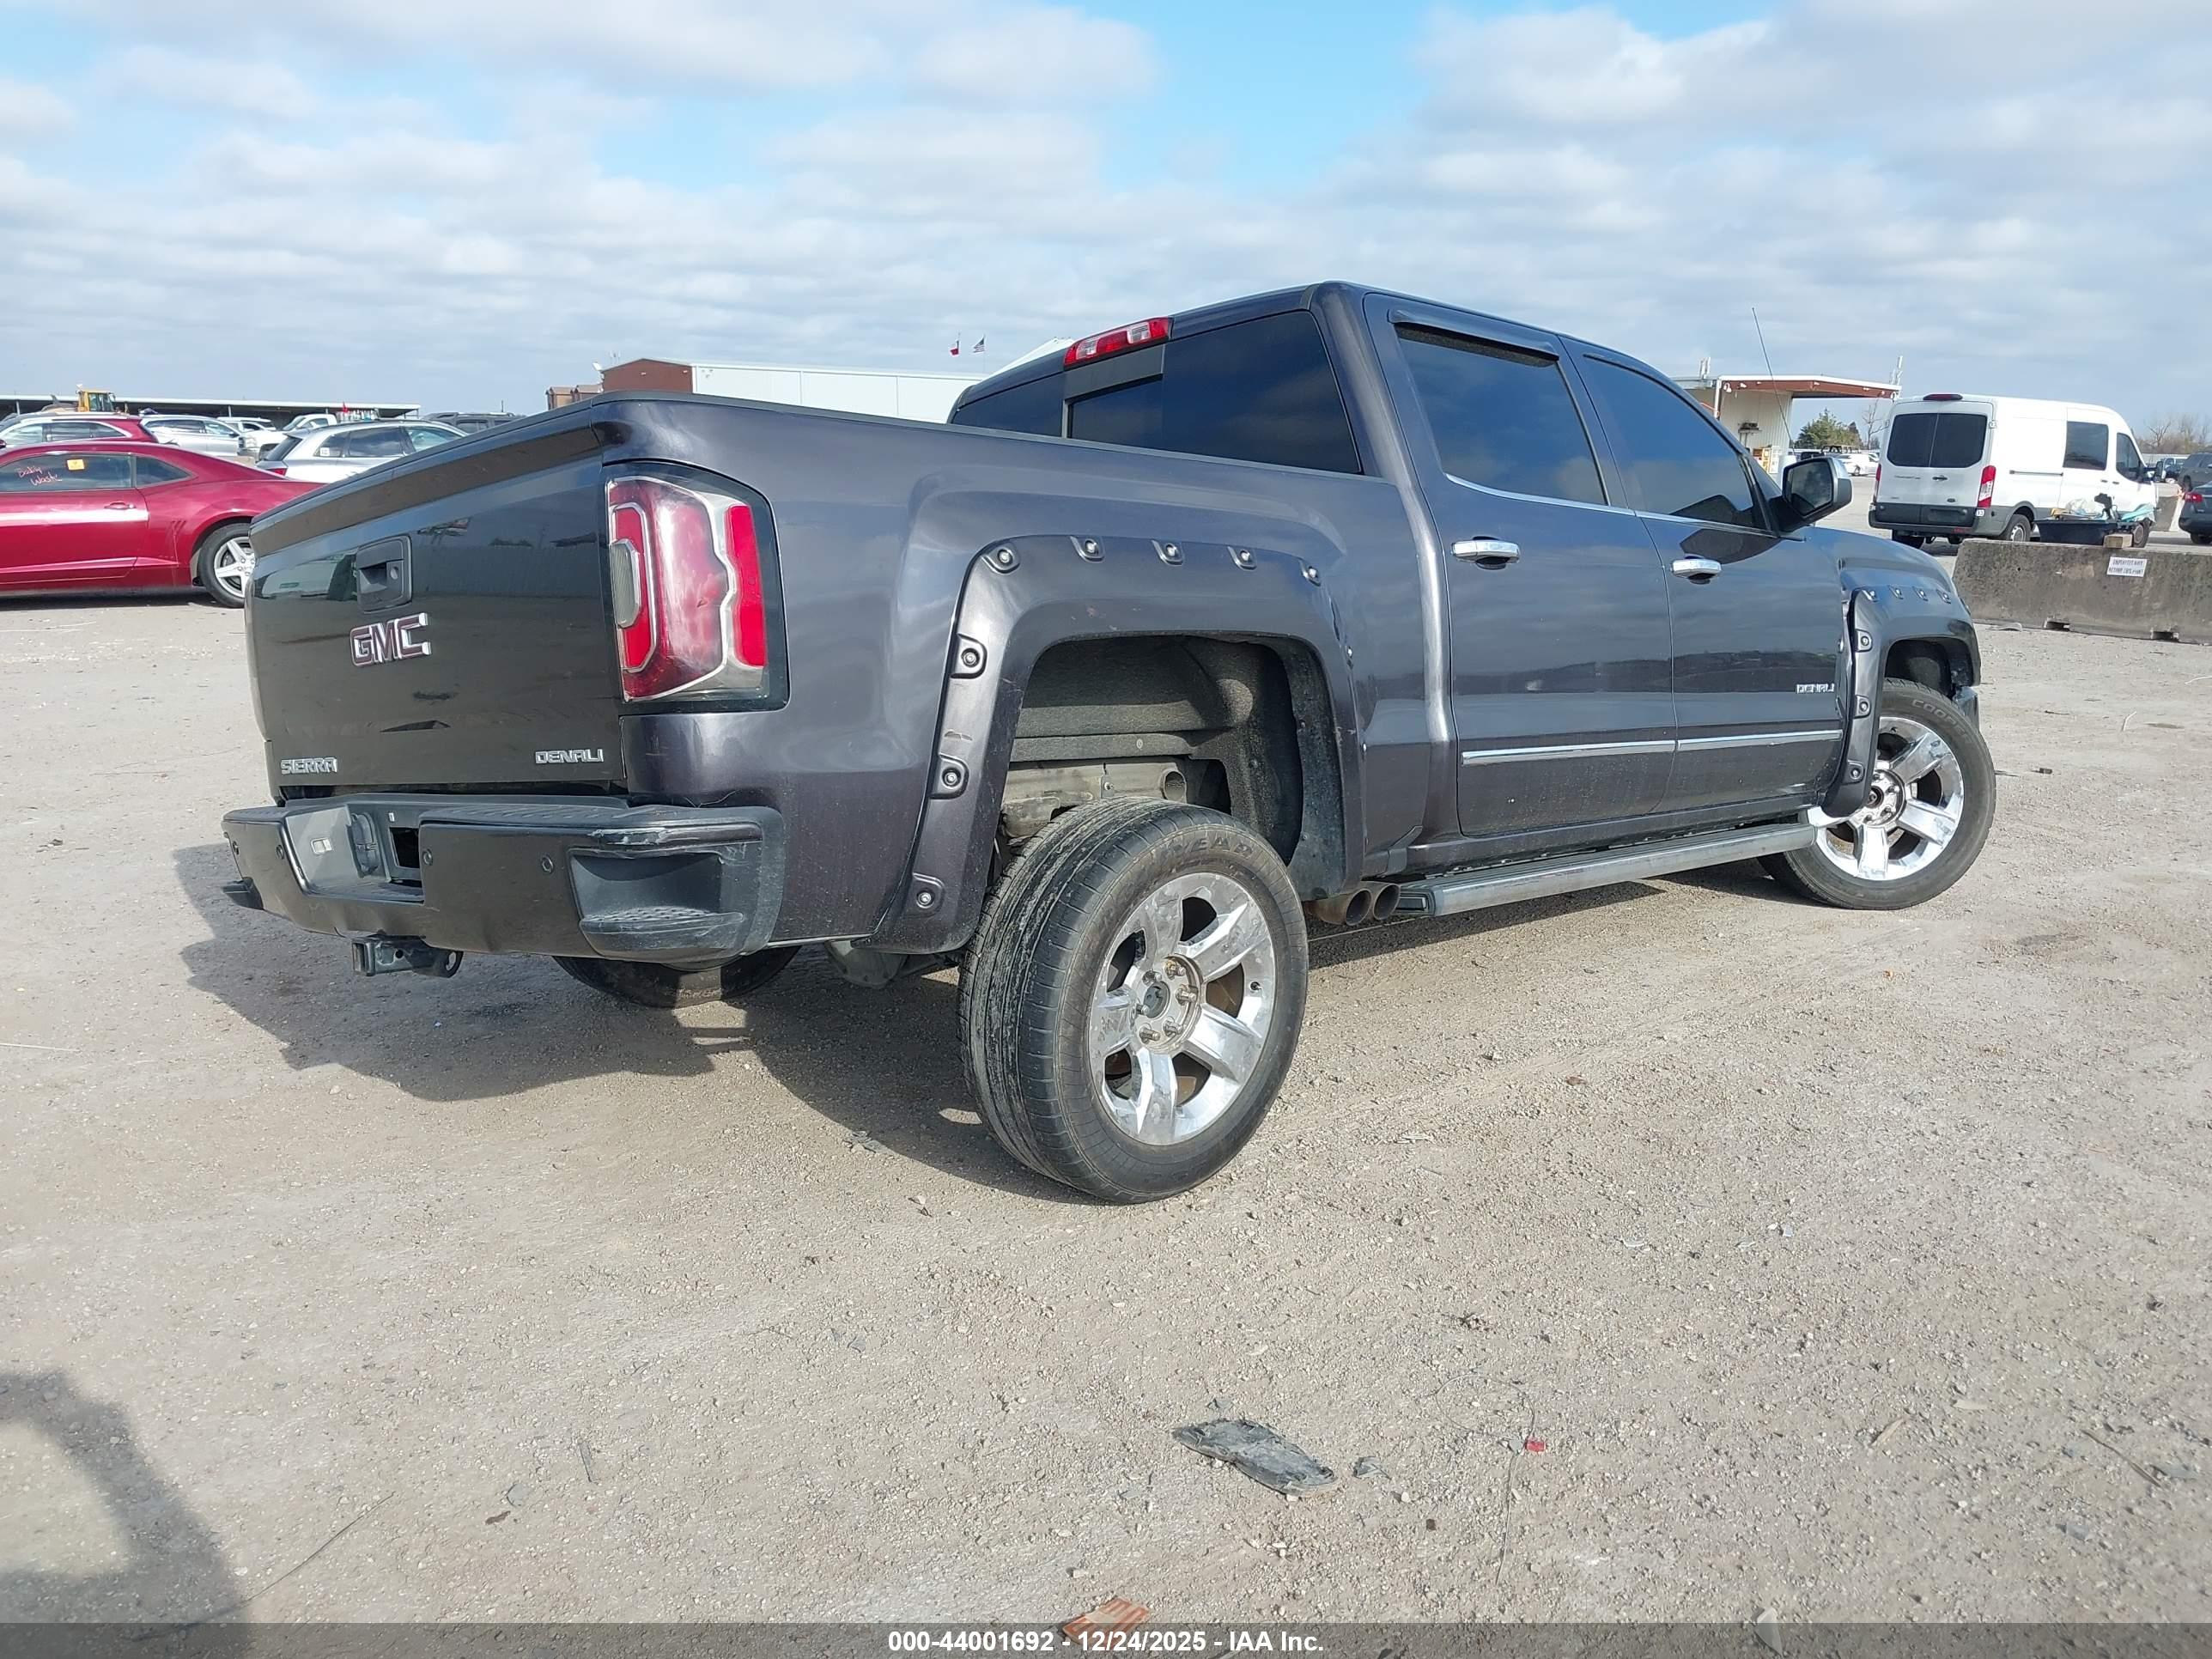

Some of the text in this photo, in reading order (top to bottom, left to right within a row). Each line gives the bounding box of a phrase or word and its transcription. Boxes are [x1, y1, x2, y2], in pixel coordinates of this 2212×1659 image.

[350, 611, 432, 666] GMC
[535, 748, 605, 764] DENALI
[280, 757, 337, 775] SIERRA
